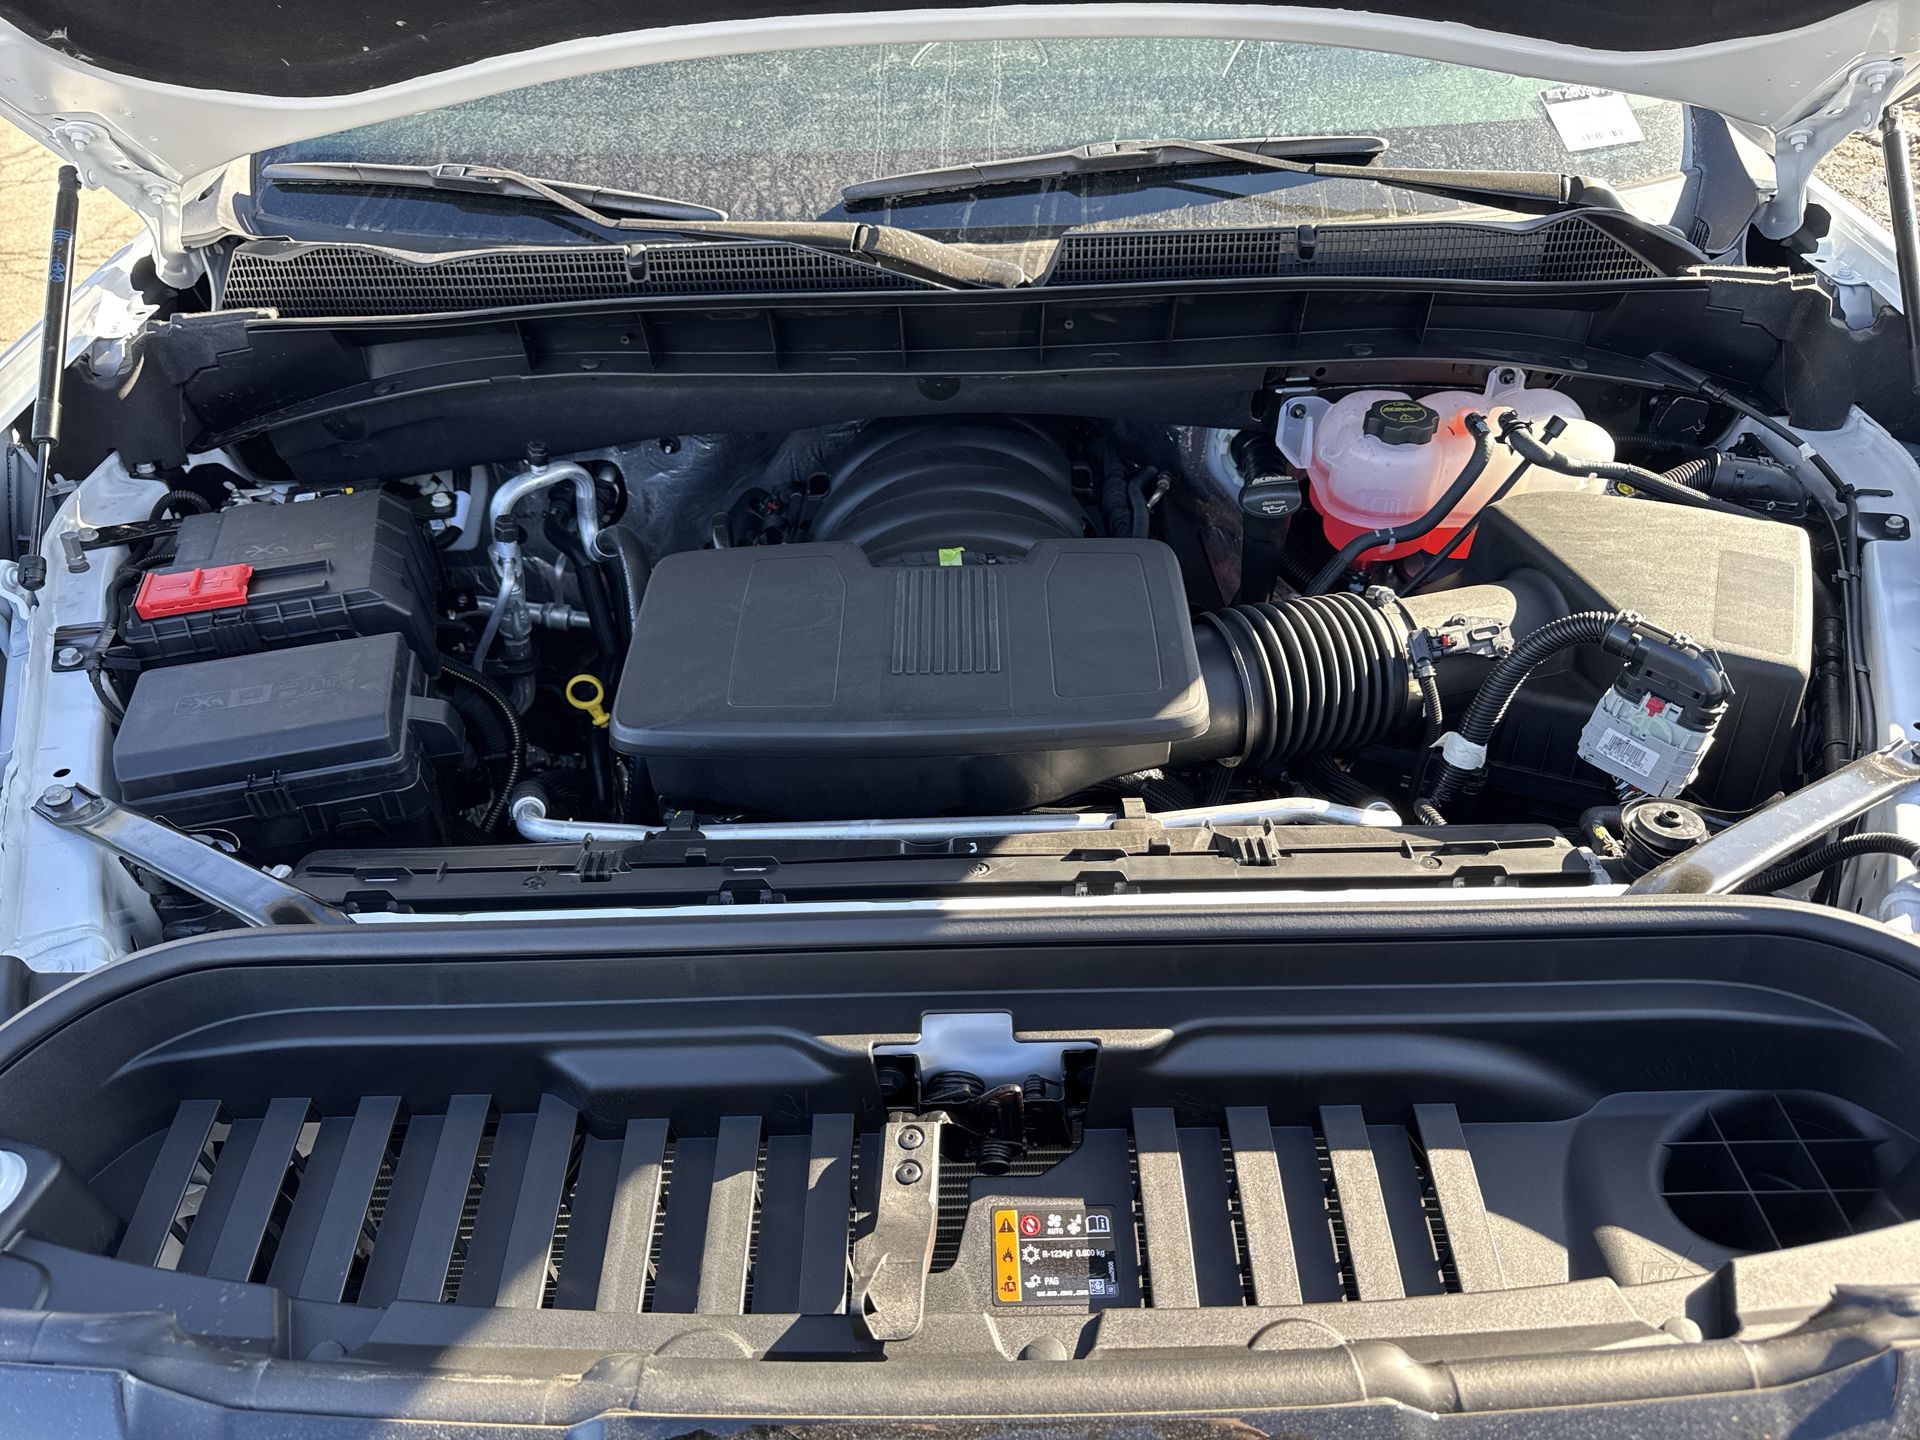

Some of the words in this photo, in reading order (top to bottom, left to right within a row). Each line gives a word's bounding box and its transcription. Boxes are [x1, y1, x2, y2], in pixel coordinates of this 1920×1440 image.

[1252, 476, 1293, 485] ACDelco
[1047, 1227, 1064, 1235] AUTO
[1042, 1249, 1073, 1259] R-1234yf
[1096, 1249, 1105, 1258] kg
[1044, 1277, 1059, 1285] PAG
